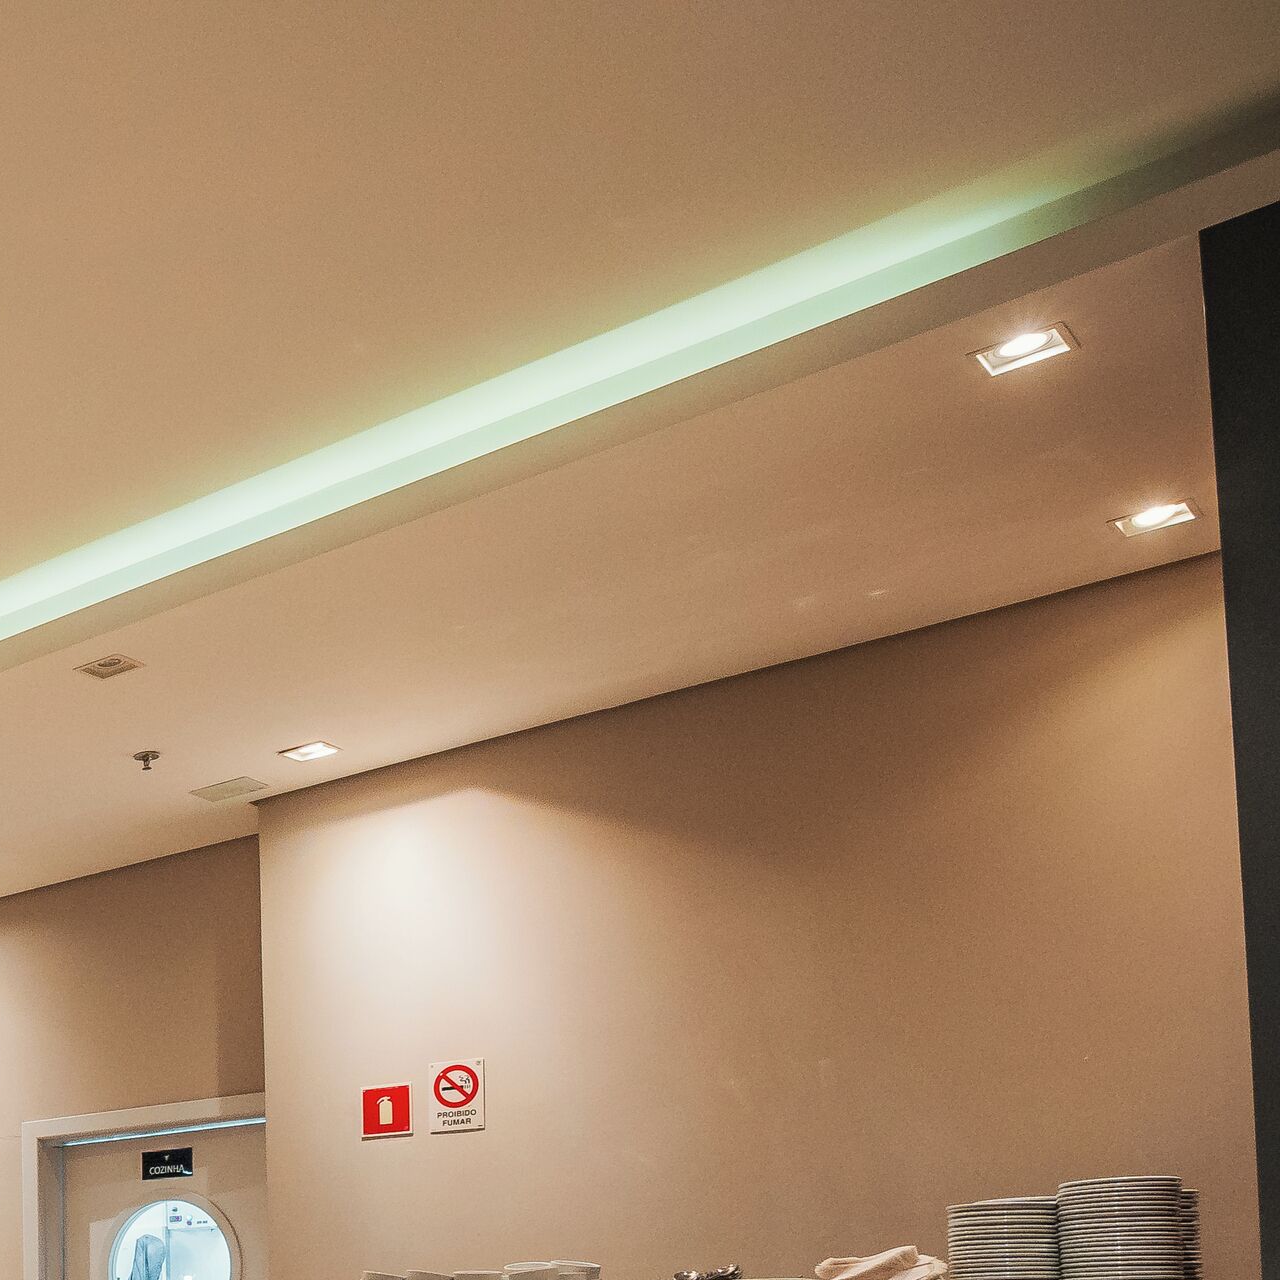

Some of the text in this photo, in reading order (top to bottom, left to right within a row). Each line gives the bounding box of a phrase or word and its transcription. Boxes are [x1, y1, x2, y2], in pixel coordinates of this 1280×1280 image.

[437, 1109, 477, 1119] PROIBIDO
[442, 1118, 472, 1126] FUMAR
[149, 1164, 185, 1175] COZINHA
